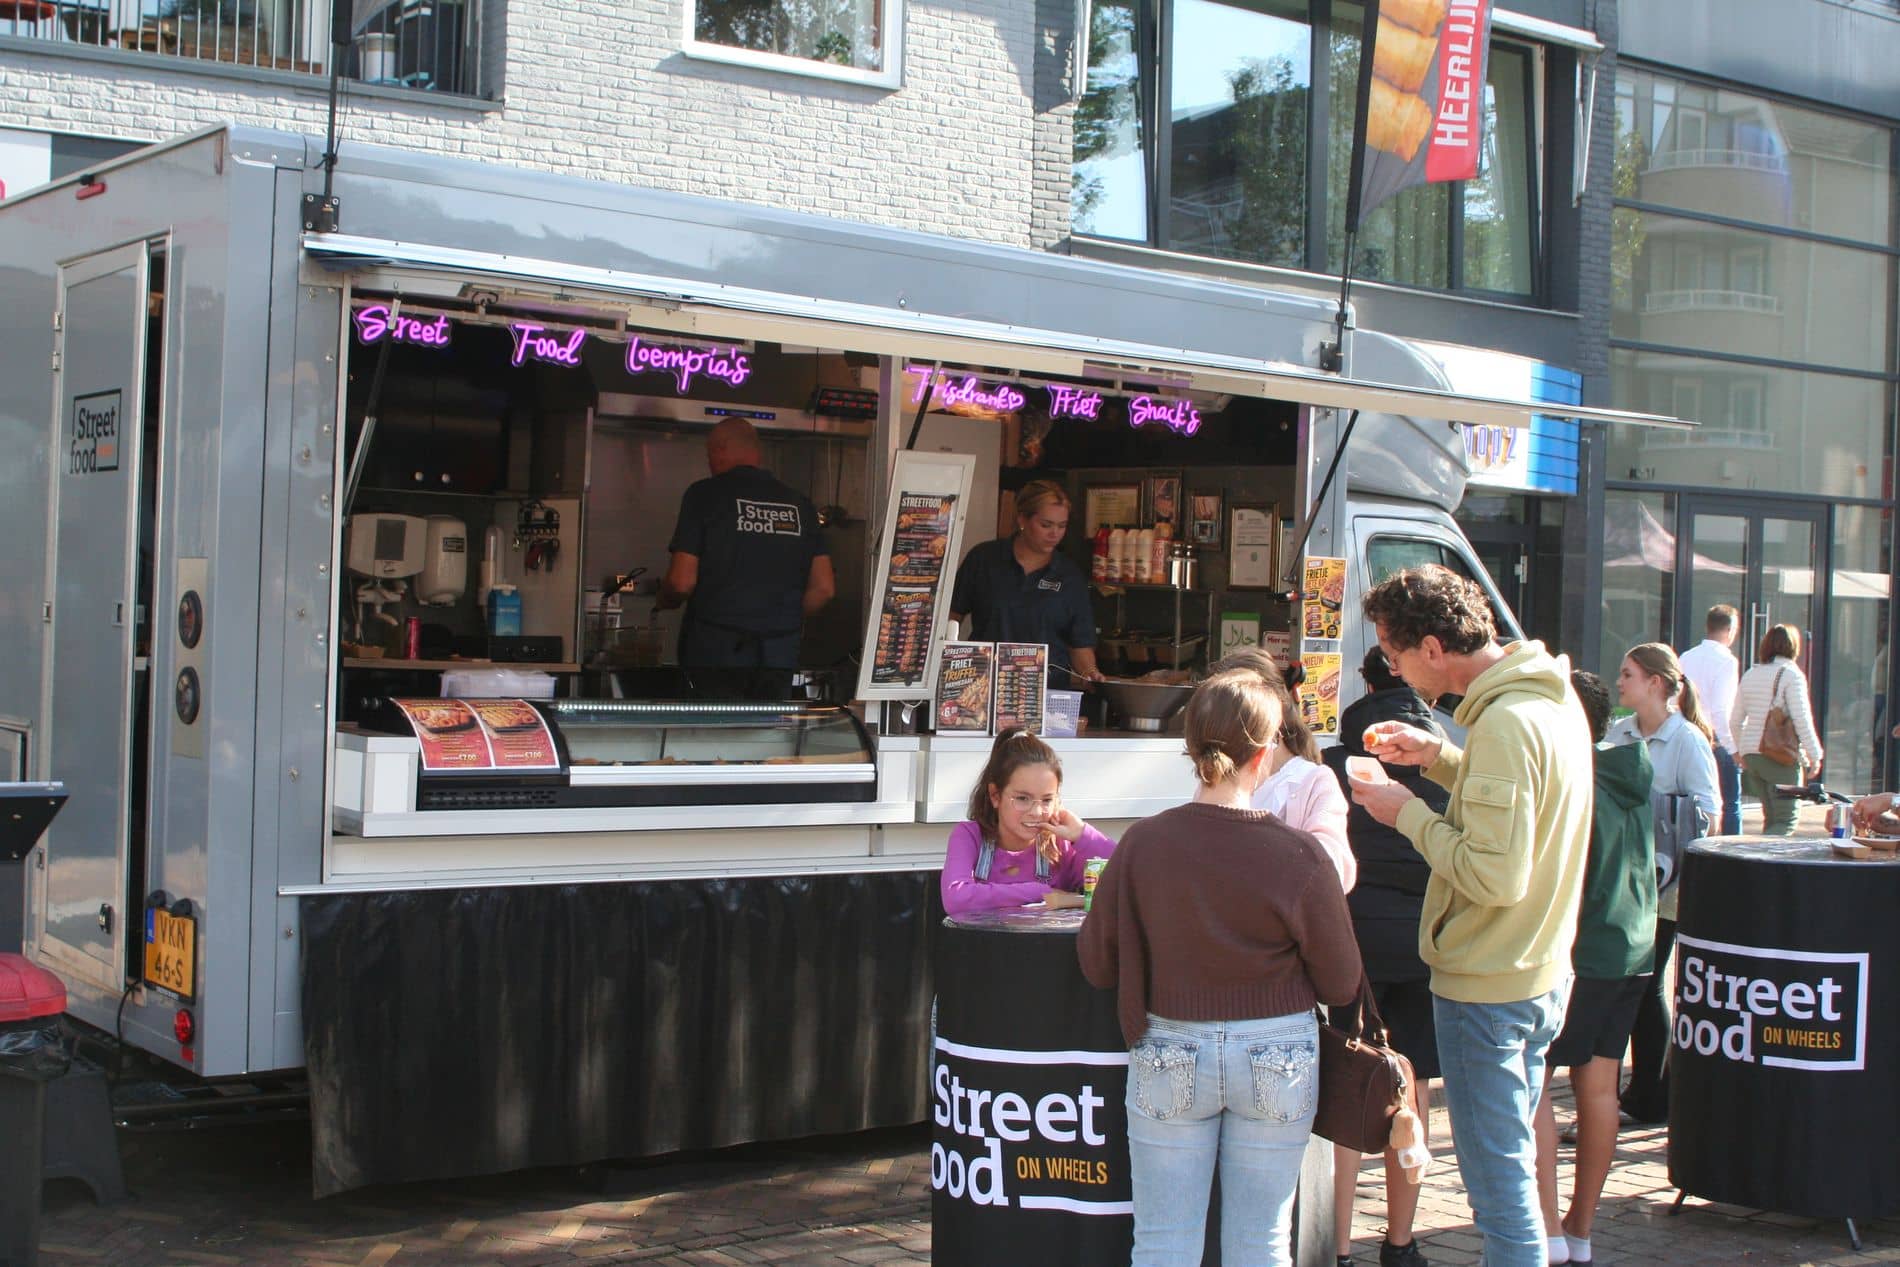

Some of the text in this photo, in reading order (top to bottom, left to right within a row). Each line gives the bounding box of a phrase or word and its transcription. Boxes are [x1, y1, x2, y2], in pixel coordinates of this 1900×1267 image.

[515, 324, 585, 363] Food
[629, 337, 750, 390] Loempia's
[78, 406, 116, 440] Street
[1049, 385, 1200, 434] Friet Snack's
[70, 439, 97, 474] food
[737, 516, 775, 534] food
[745, 505, 795, 522] Street
[1305, 567, 1329, 579] FRIETJE
[943, 666, 977, 683] TRUFFEL
[950, 658, 974, 670] FRIET
[161, 914, 186, 950] VKN
[155, 952, 183, 988] 46-S
[1683, 956, 1842, 1022] Street
[1763, 1026, 1841, 1049] ON WHEELS
[934, 1064, 1106, 1146] Street
[1016, 1156, 1108, 1185] ON WHEELS
